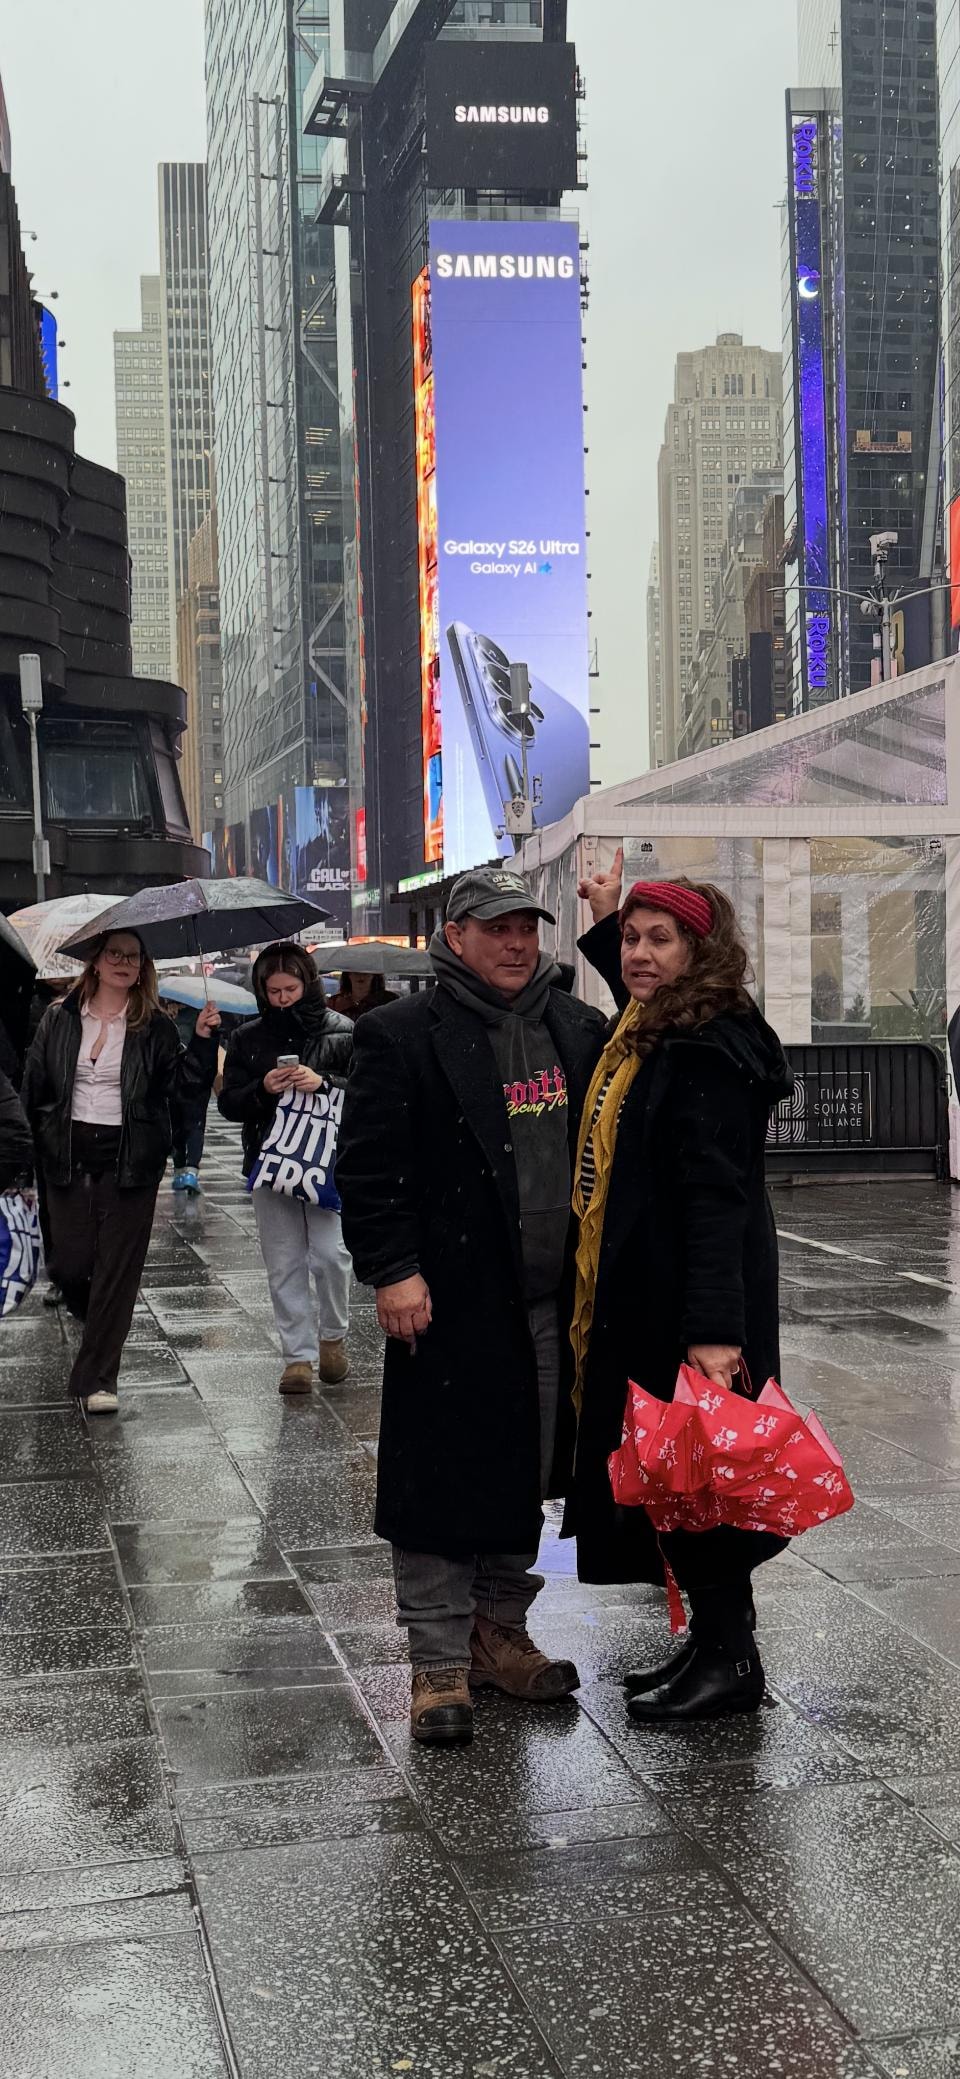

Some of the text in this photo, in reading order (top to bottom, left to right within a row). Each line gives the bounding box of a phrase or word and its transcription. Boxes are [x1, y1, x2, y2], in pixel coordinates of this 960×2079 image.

[455, 105, 549, 123] SAMSUNG
[437, 254, 574, 279] SAMSUNG
[444, 540, 580, 558] Galaxy S26 Ultra
[470, 562, 537, 577] Galaxy AI
[311, 868, 344, 882] CALL
[307, 882, 350, 891] BLACK
[819, 1088, 860, 1100] TIMES
[813, 1102, 863, 1116] SQUARE
